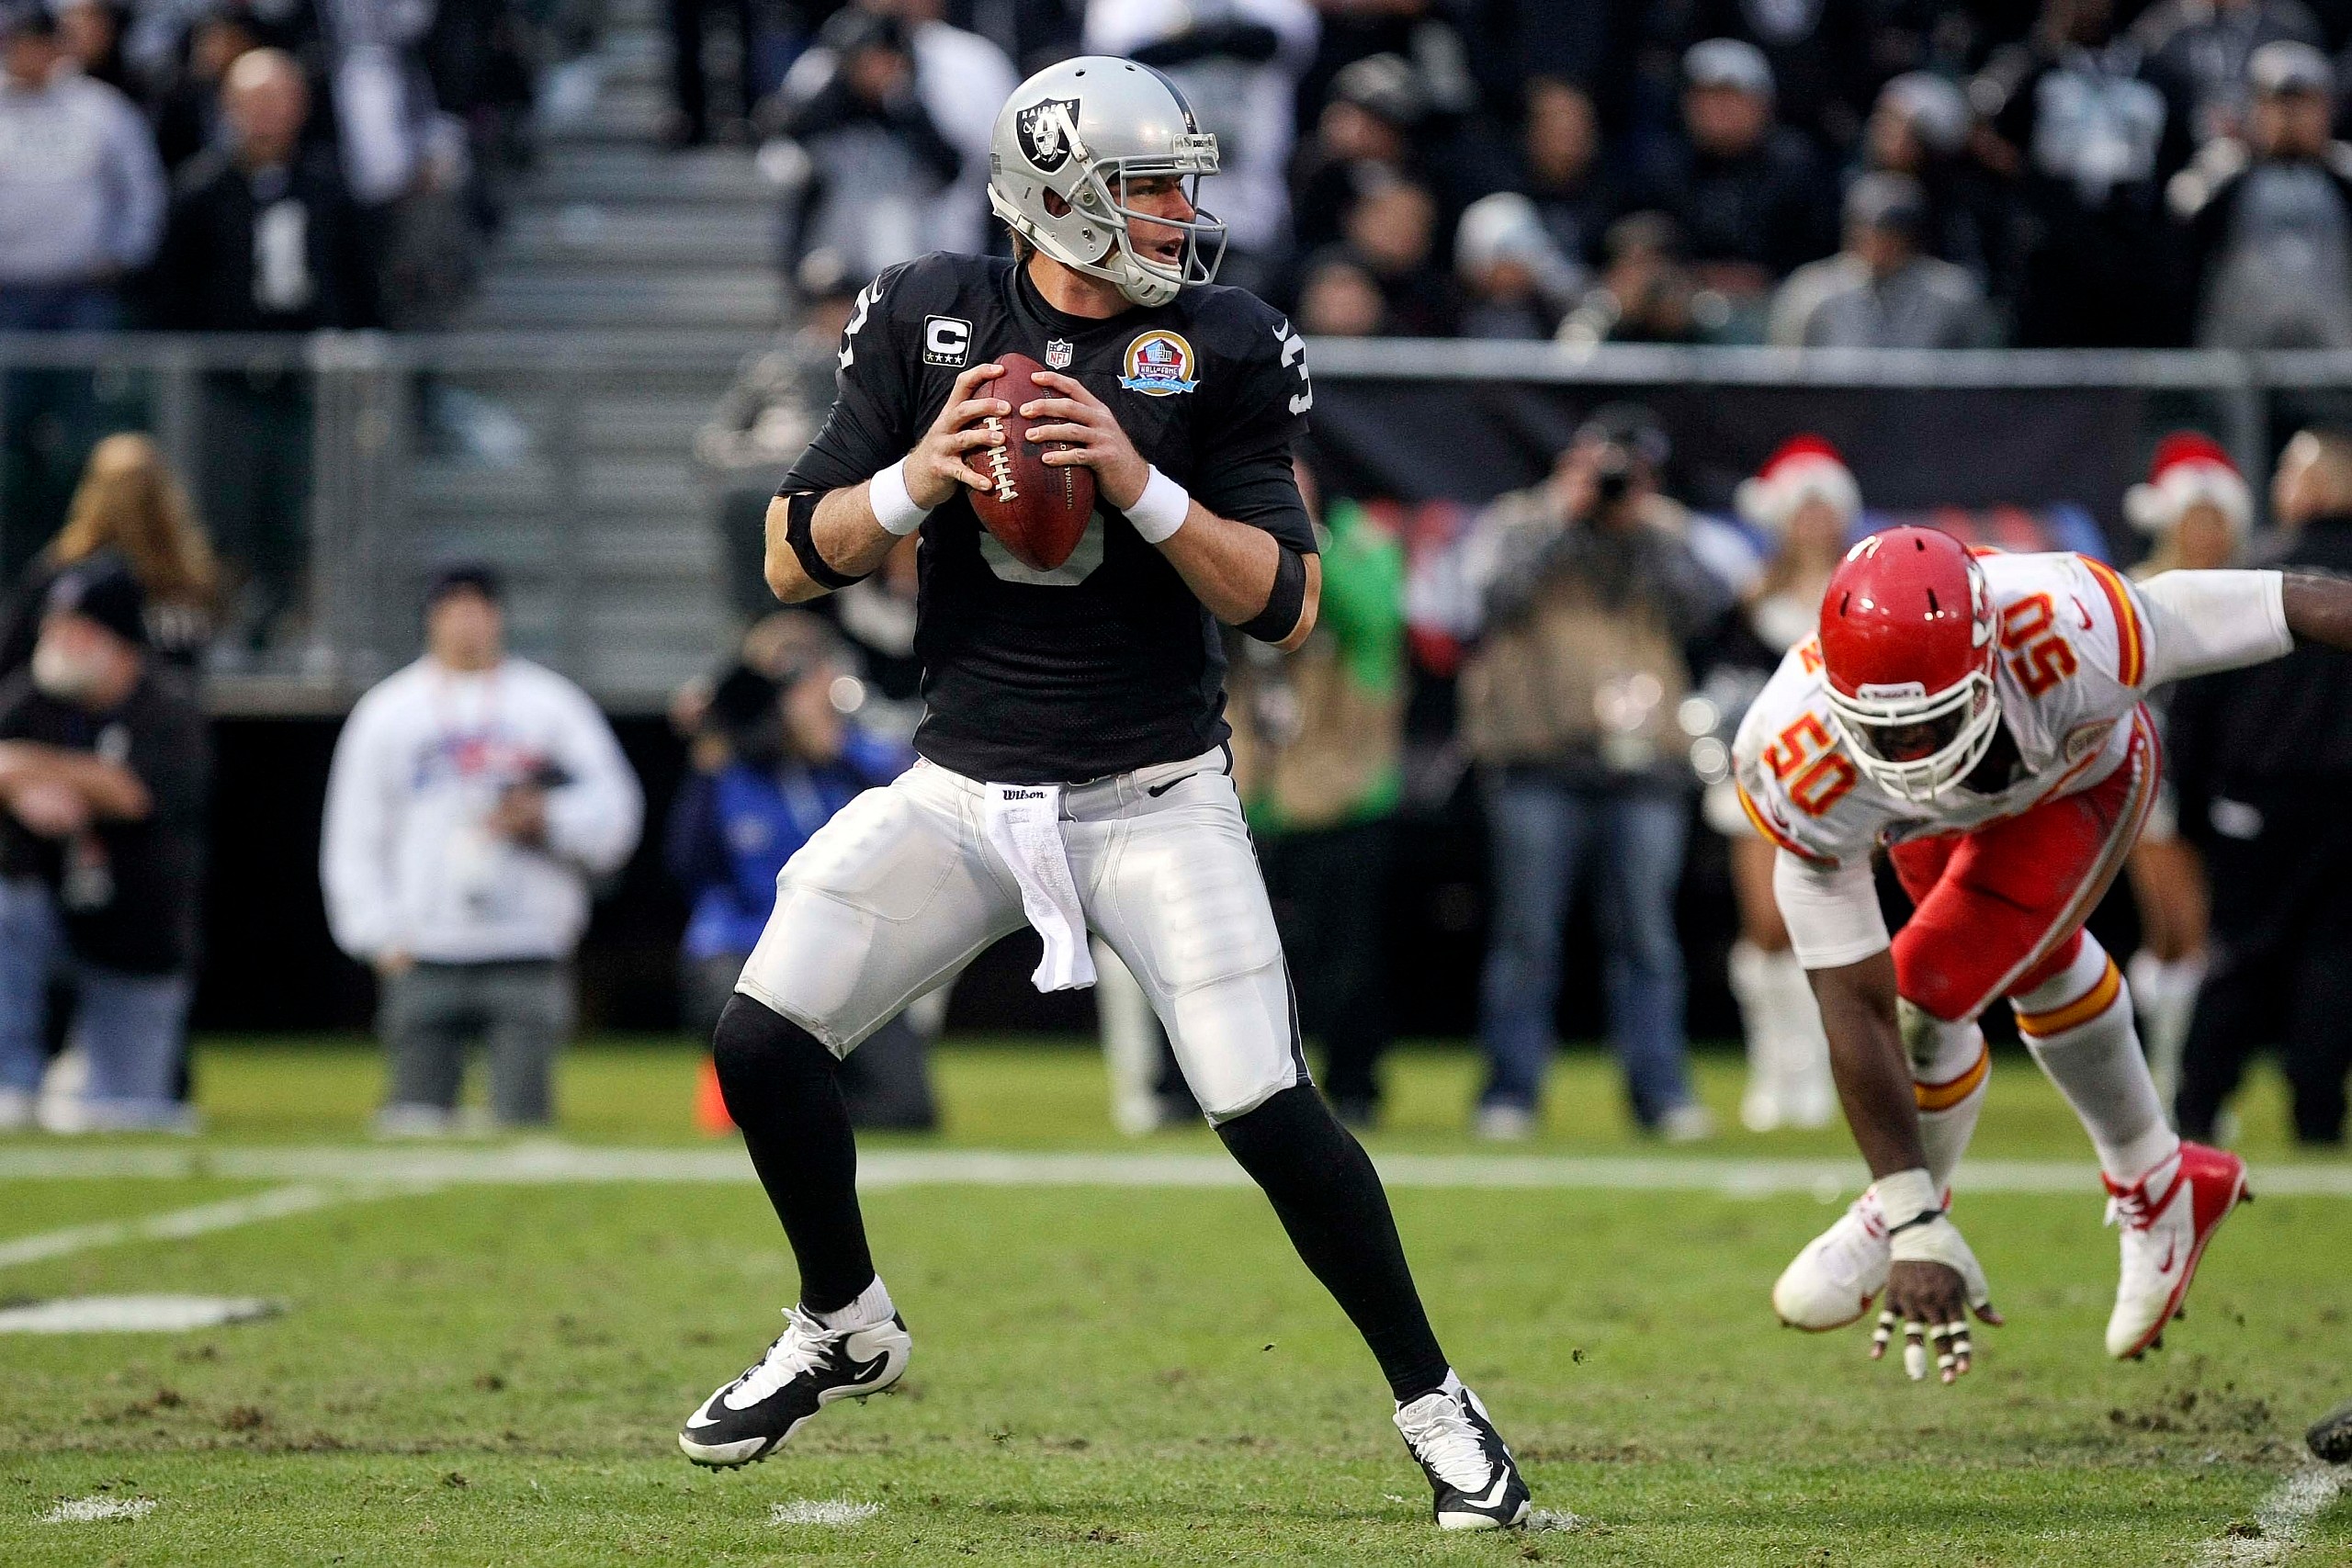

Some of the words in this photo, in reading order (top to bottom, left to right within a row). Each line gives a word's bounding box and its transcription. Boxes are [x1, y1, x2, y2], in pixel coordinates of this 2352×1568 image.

[927, 320, 967, 355] C
[1050, 352, 1068, 364] NFL
[1141, 366, 1157, 374] HALL
[1161, 367, 1178, 376] FAME
[1281, 333, 1313, 415] 3
[1064, 466, 1073, 510] NATIONAL
[2000, 592, 2078, 697] 50
[1759, 711, 1857, 818] 50
[1002, 789, 1045, 800] Wilson
